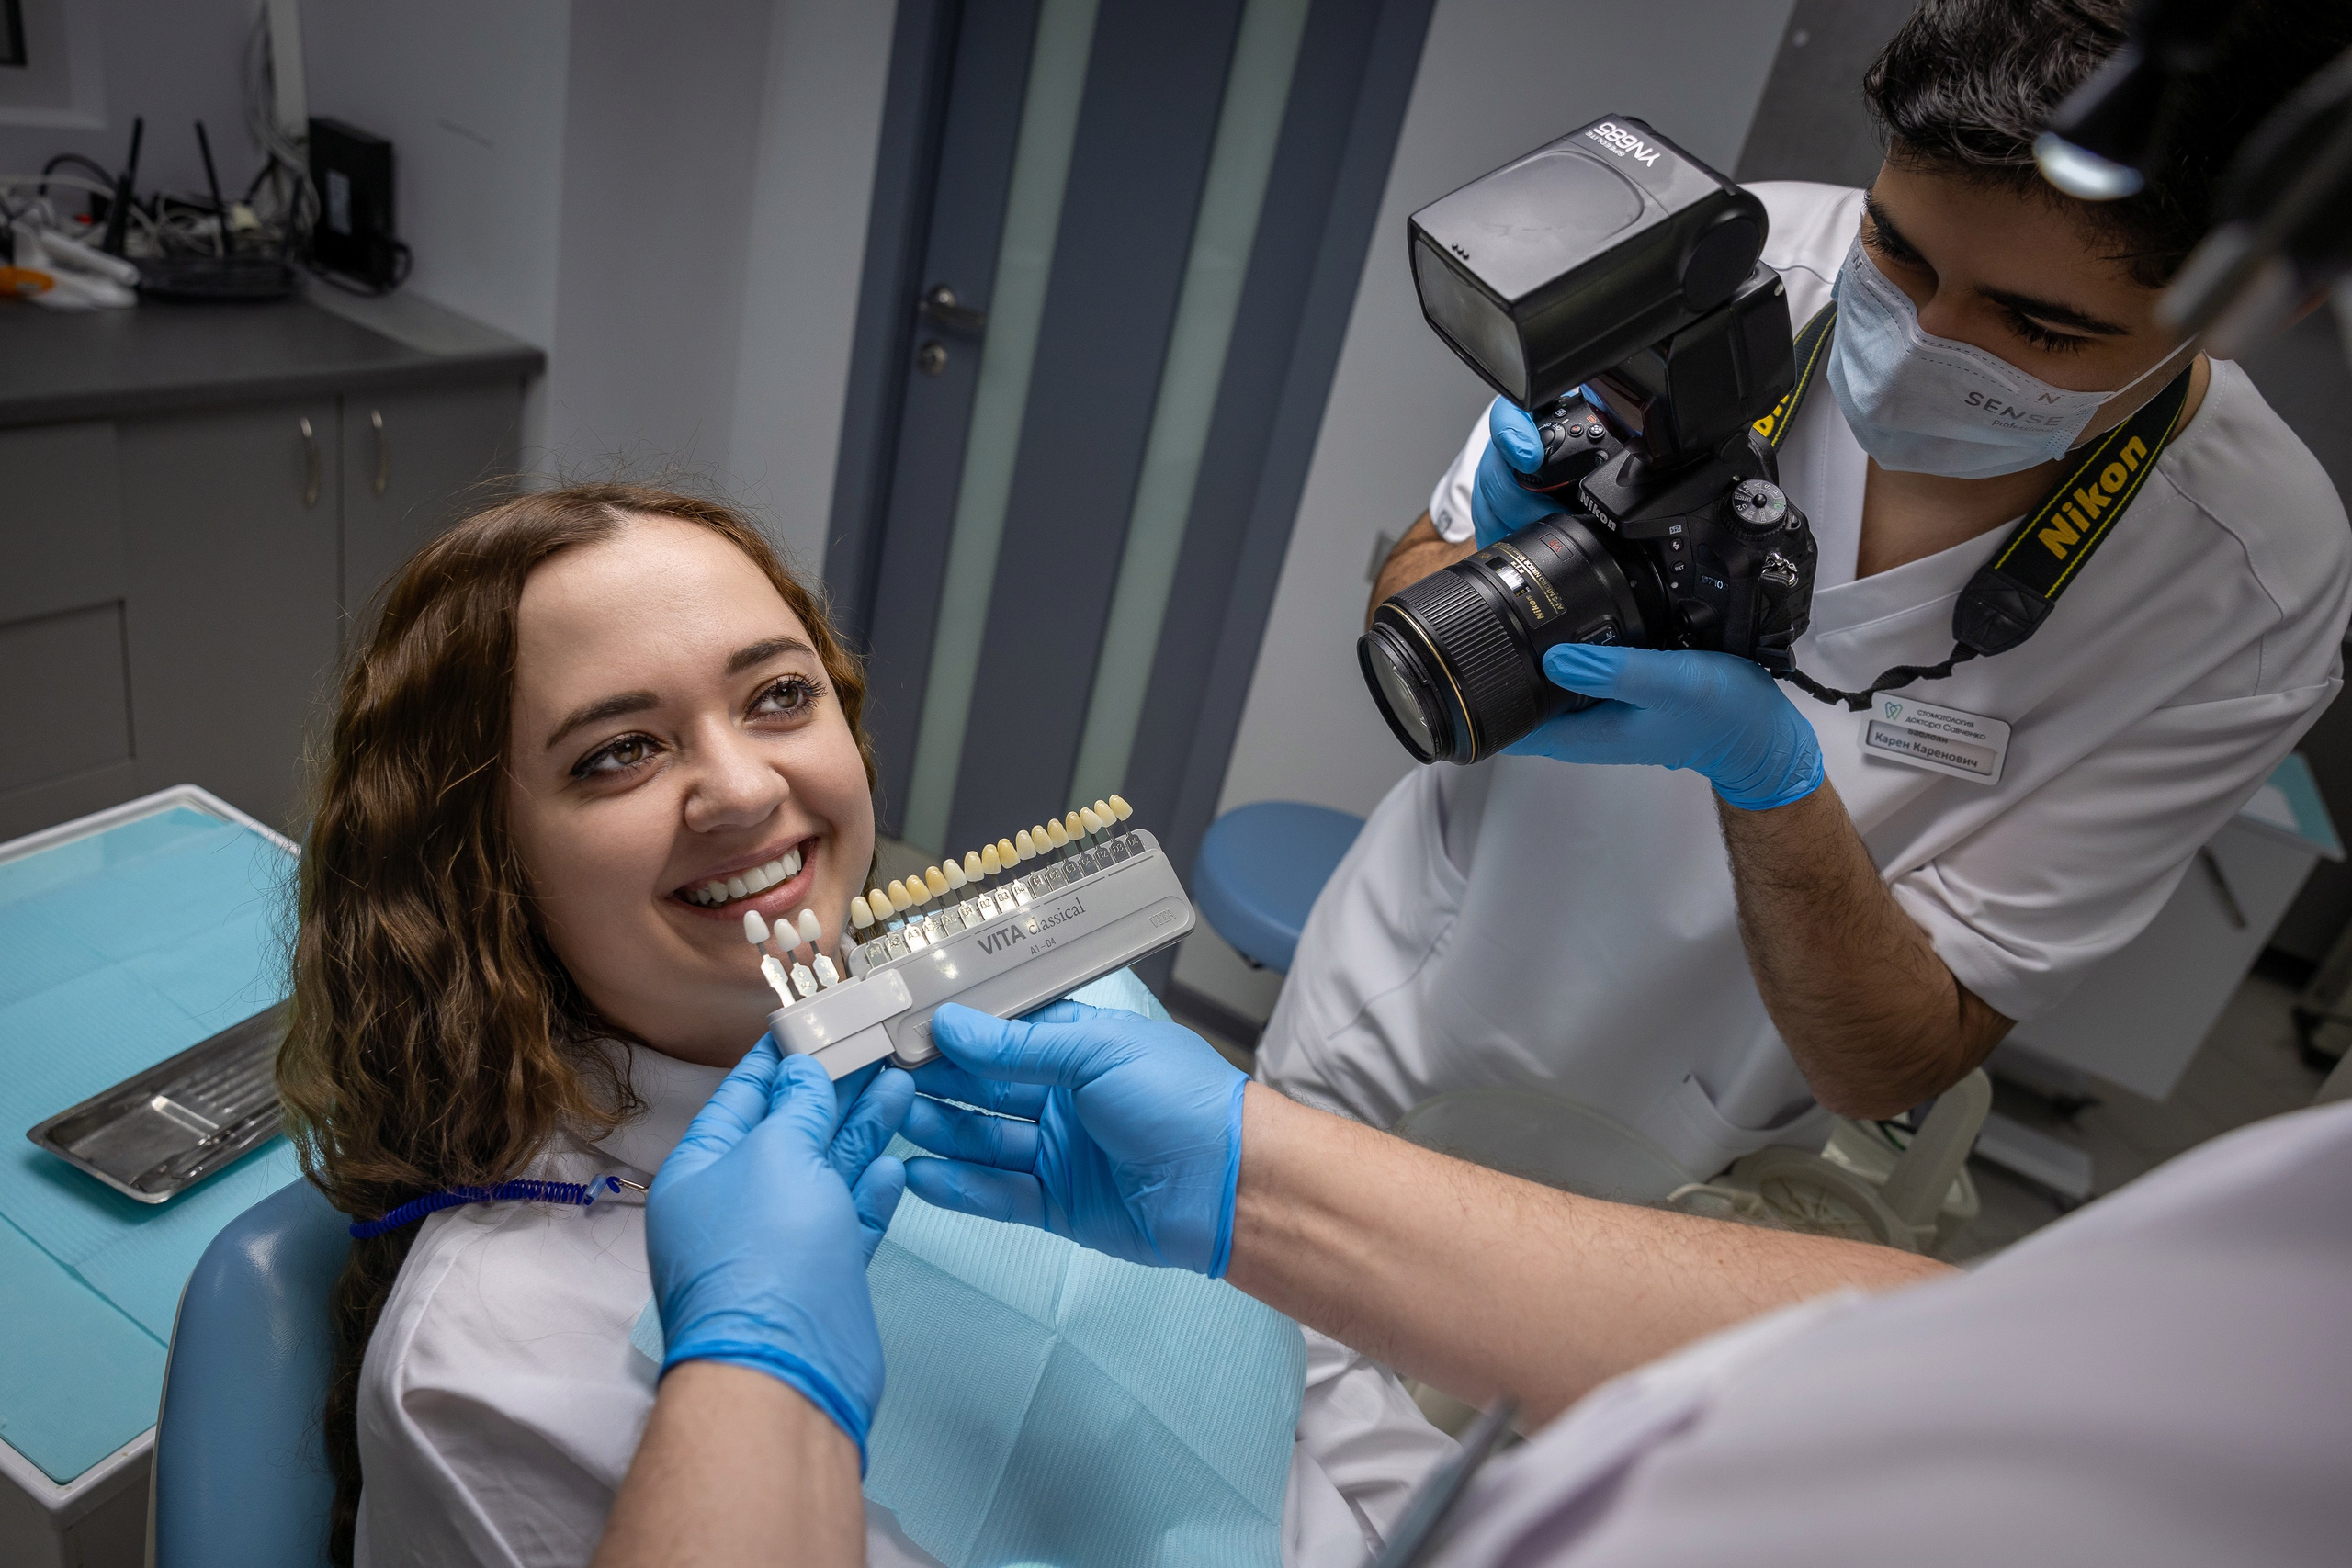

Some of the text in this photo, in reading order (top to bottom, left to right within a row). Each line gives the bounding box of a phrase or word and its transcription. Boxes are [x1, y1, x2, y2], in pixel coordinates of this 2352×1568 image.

[1585, 130, 1626, 157] SPEEDLITE
[1593, 121, 1661, 167] YN685
[1964, 391, 2064, 426] SENSE
[1992, 419, 2054, 434] professional
[2037, 435, 2148, 560] Nikon
[1580, 491, 1617, 532] Nikon
[1736, 503, 1748, 512] U2
[1548, 538, 1563, 553] VR
[1523, 558, 1541, 578] NIKKOR
[1525, 594, 1545, 620] Nikon
[1551, 595, 1565, 610] AF-S
[1917, 709, 1974, 728] стоматология
[1905, 716, 1986, 740] доктора Савченко
[1874, 732, 1978, 768] Карен Каренович
[1114, 844, 1125, 853] D3
[1128, 837, 1139, 847] D4
[1097, 851, 1109, 860] D2
[1048, 870, 1061, 880] C2
[1065, 863, 1076, 874] C3
[1033, 875, 1044, 886] C1
[979, 898, 991, 909] B2
[998, 892, 1011, 902] B3
[1148, 908, 1177, 928] VITA
[976, 897, 1086, 955] VITA classical
[908, 929, 920, 940] A3
[888, 937, 901, 951] A2
